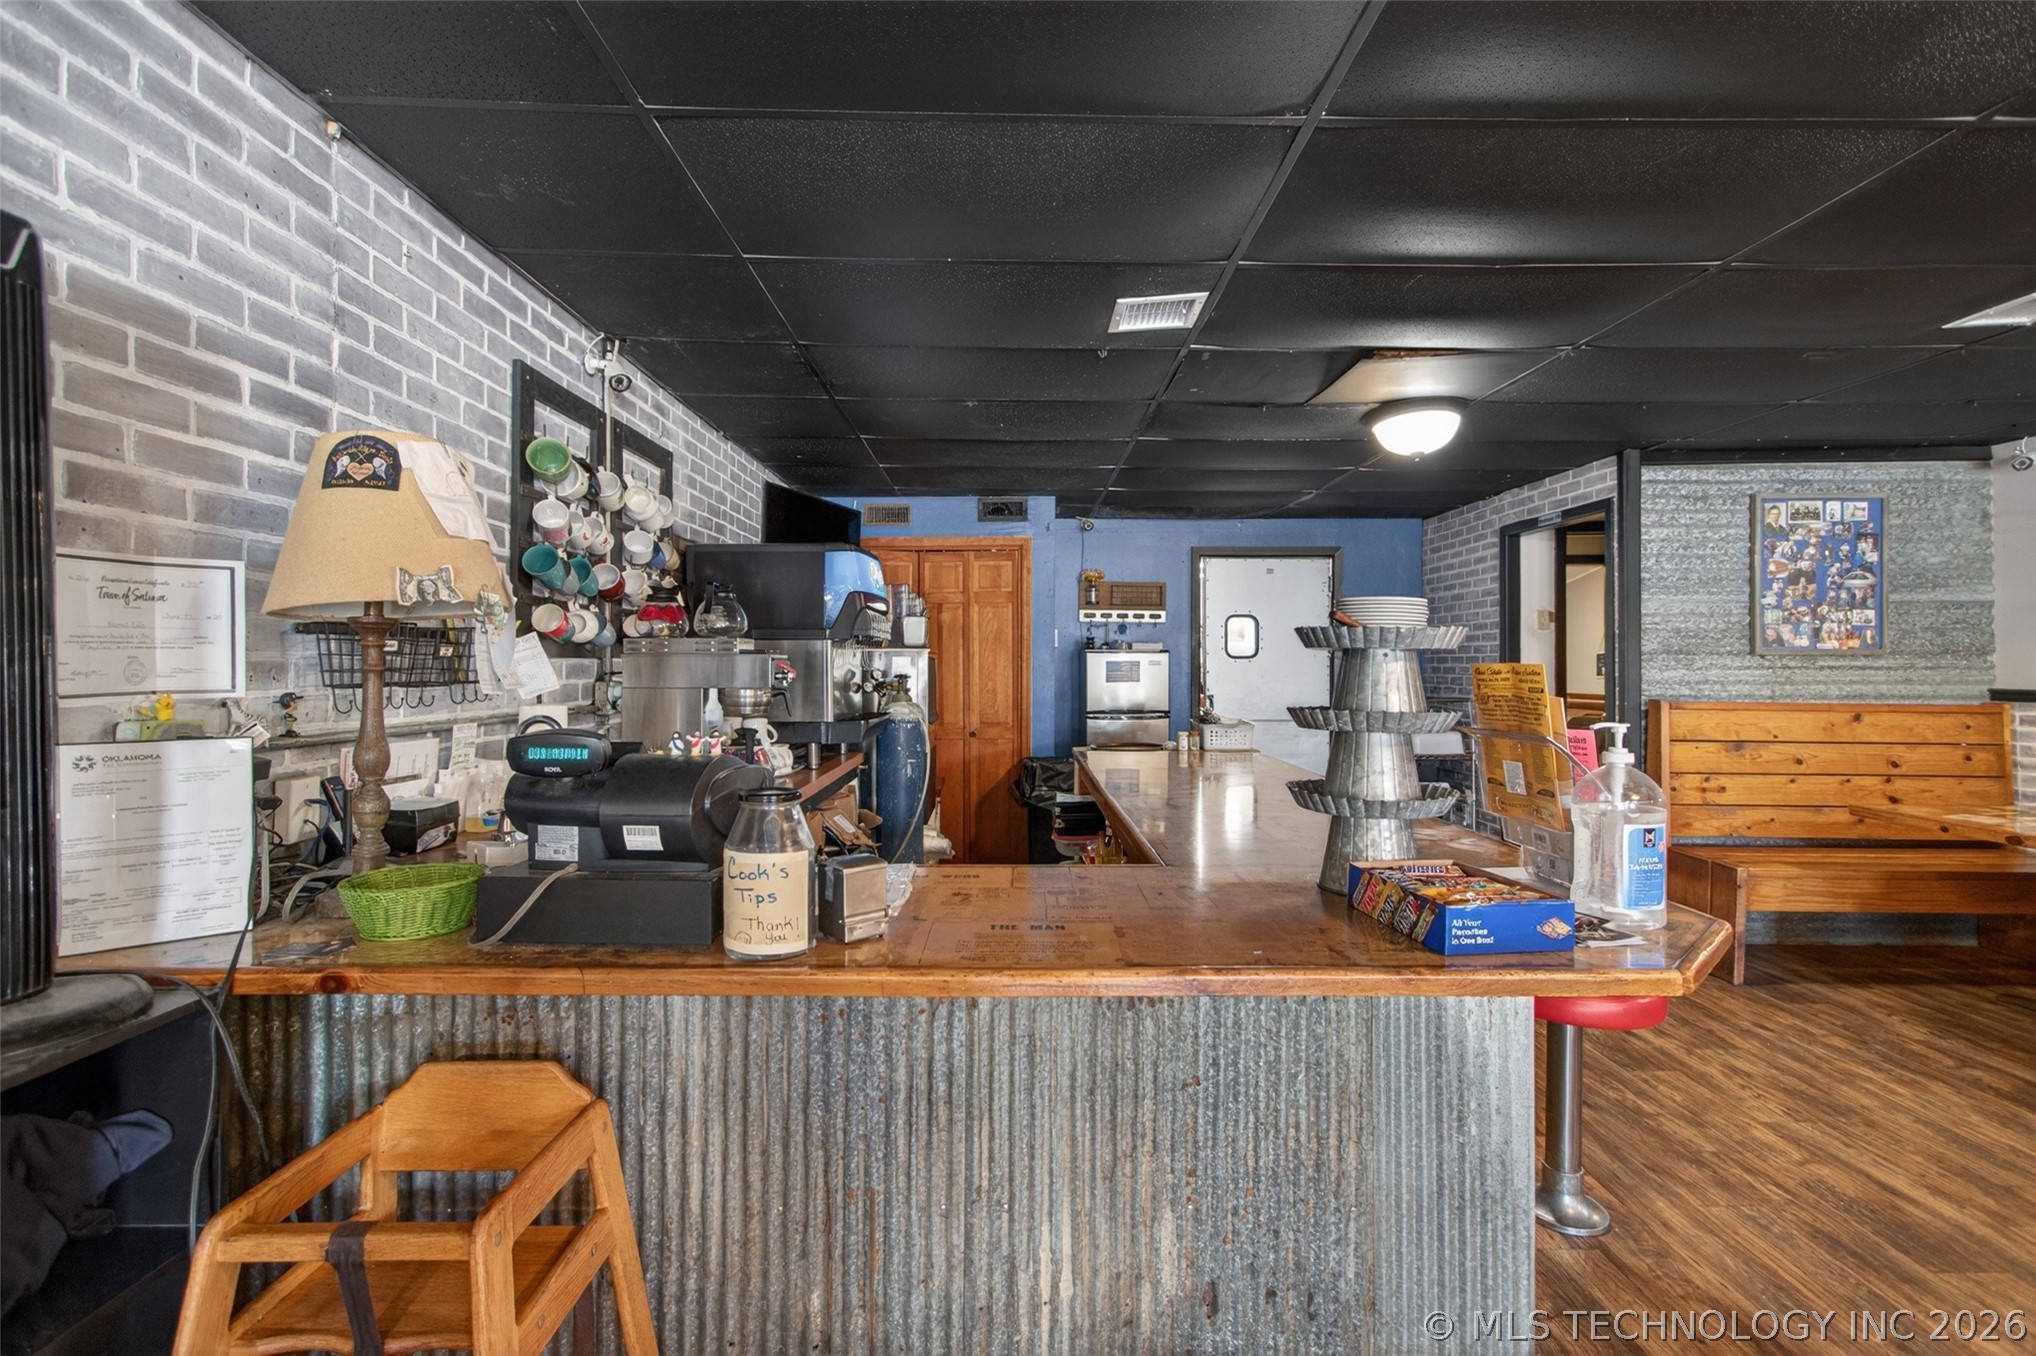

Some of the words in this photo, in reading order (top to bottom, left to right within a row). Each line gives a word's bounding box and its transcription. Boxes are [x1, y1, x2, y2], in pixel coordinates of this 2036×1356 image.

[101, 752, 162, 764] OKLAHOMA
[727, 855, 790, 881] Cook's
[734, 887, 778, 909] Tips
[765, 931, 788, 946] You
